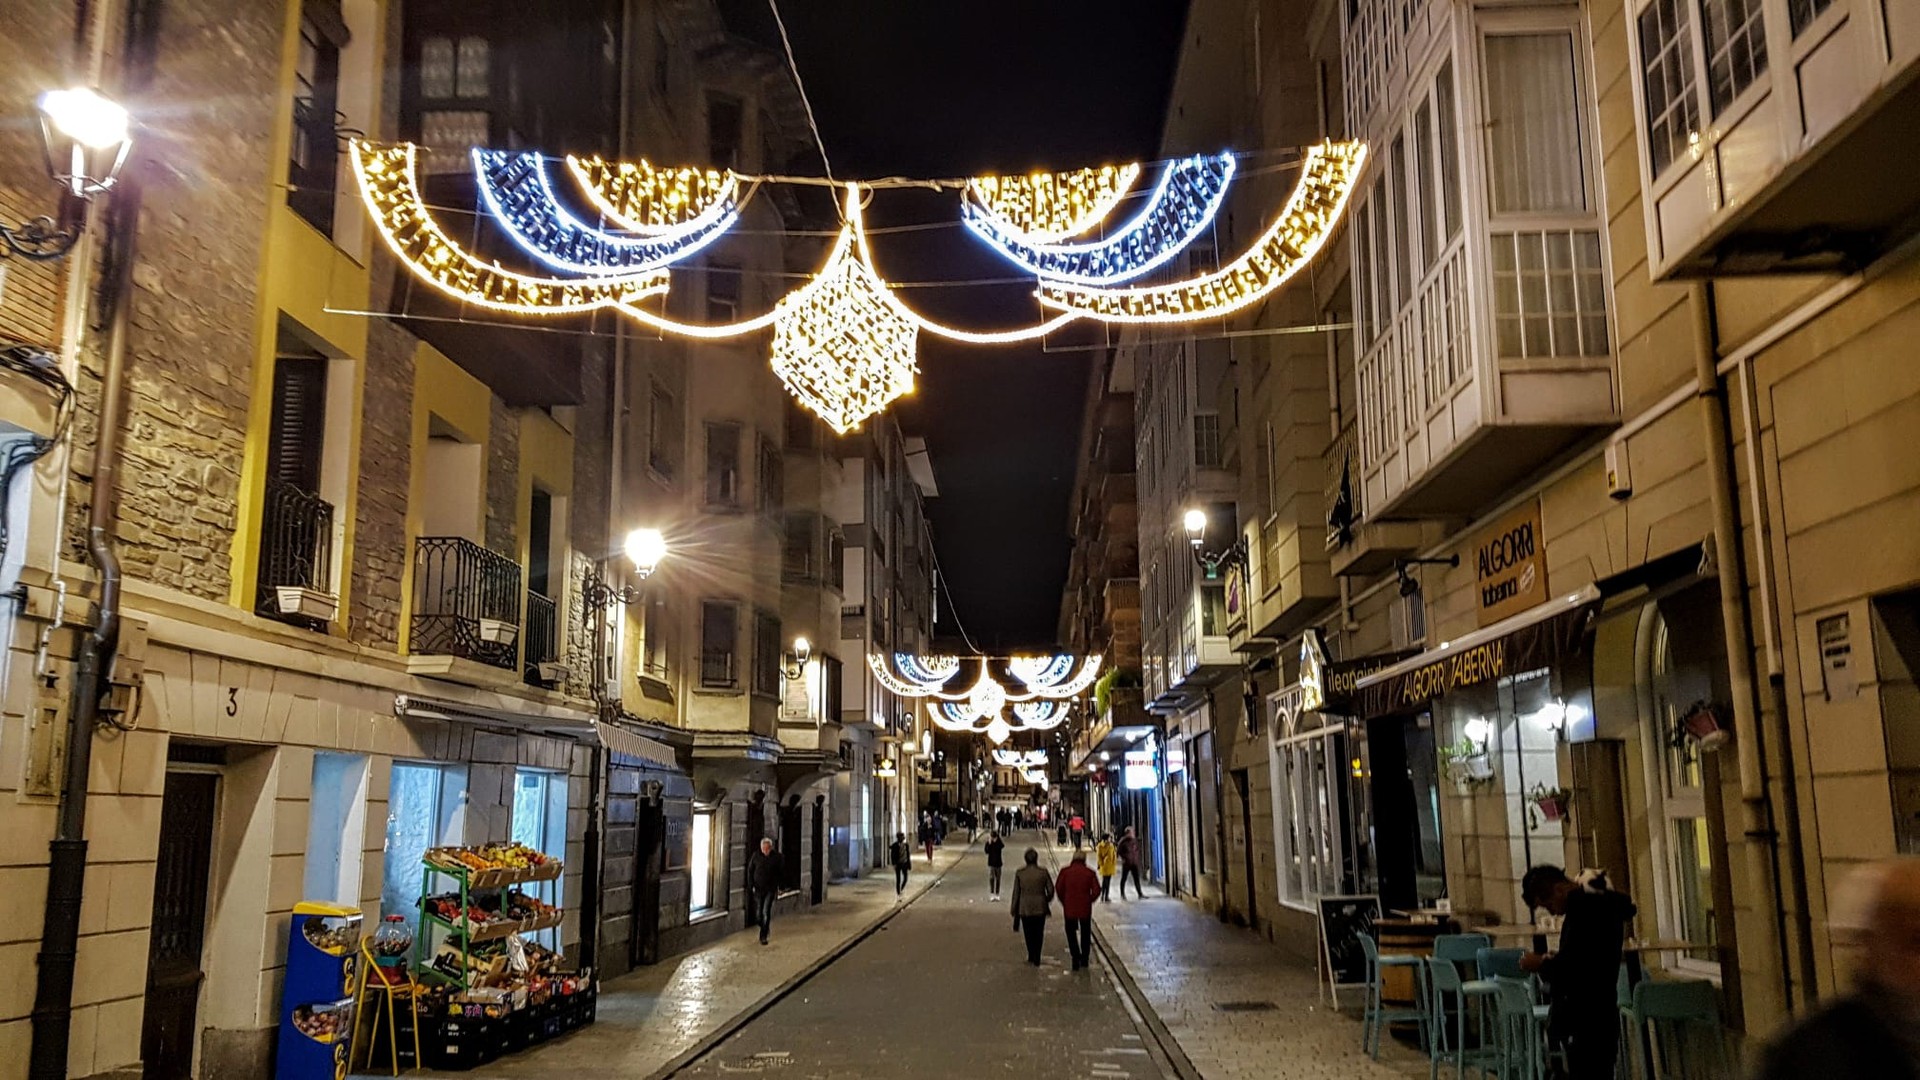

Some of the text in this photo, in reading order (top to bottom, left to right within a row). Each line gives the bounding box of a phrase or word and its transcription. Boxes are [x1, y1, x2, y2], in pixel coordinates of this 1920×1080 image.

[1478, 521, 1535, 582] ALGORRI
[1482, 577, 1518, 608] taberna
[1450, 640, 1503, 687] TABERNA
[225, 687, 239, 717] 3
